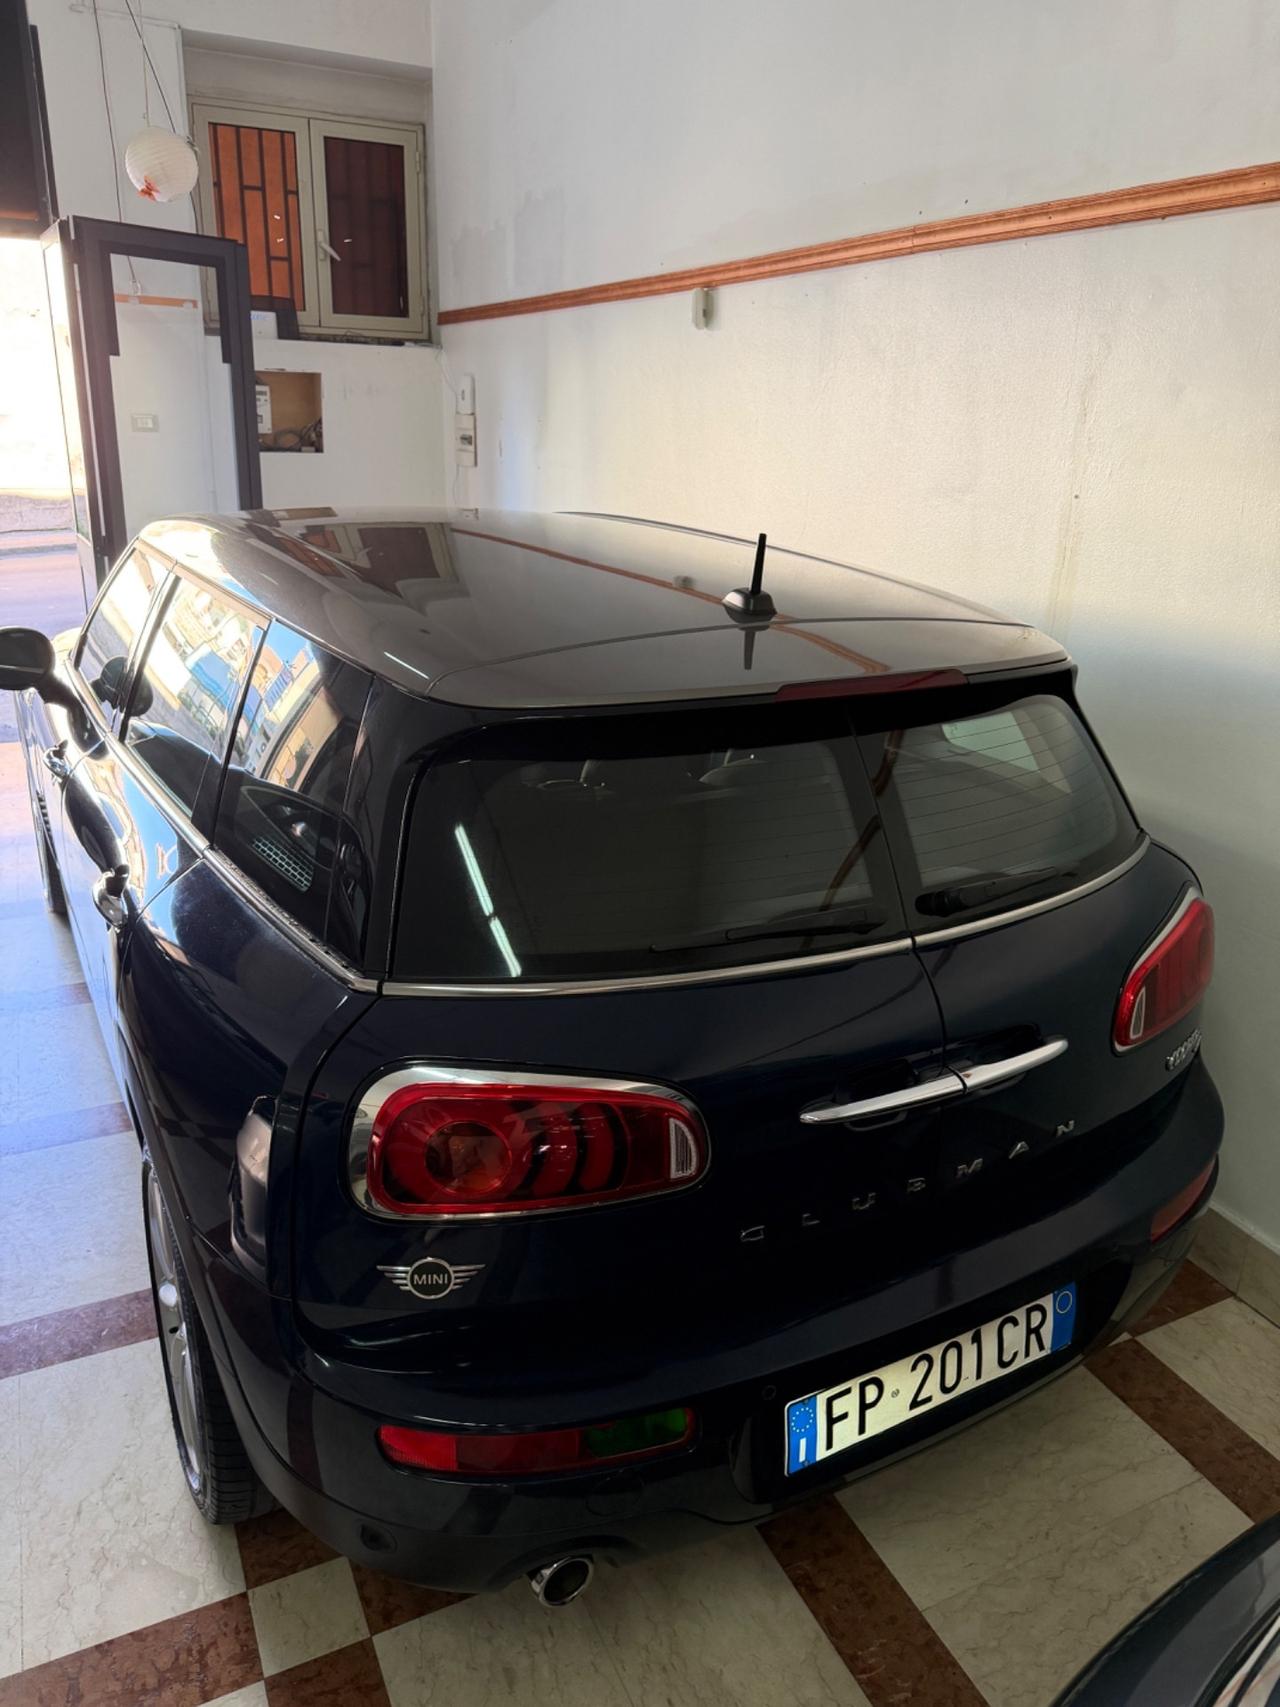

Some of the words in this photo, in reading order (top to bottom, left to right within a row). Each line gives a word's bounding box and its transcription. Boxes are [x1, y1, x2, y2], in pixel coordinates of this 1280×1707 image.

[413, 1273, 448, 1285] MINI
[825, 1376, 884, 1451] FP
[799, 1438, 806, 1463] I
